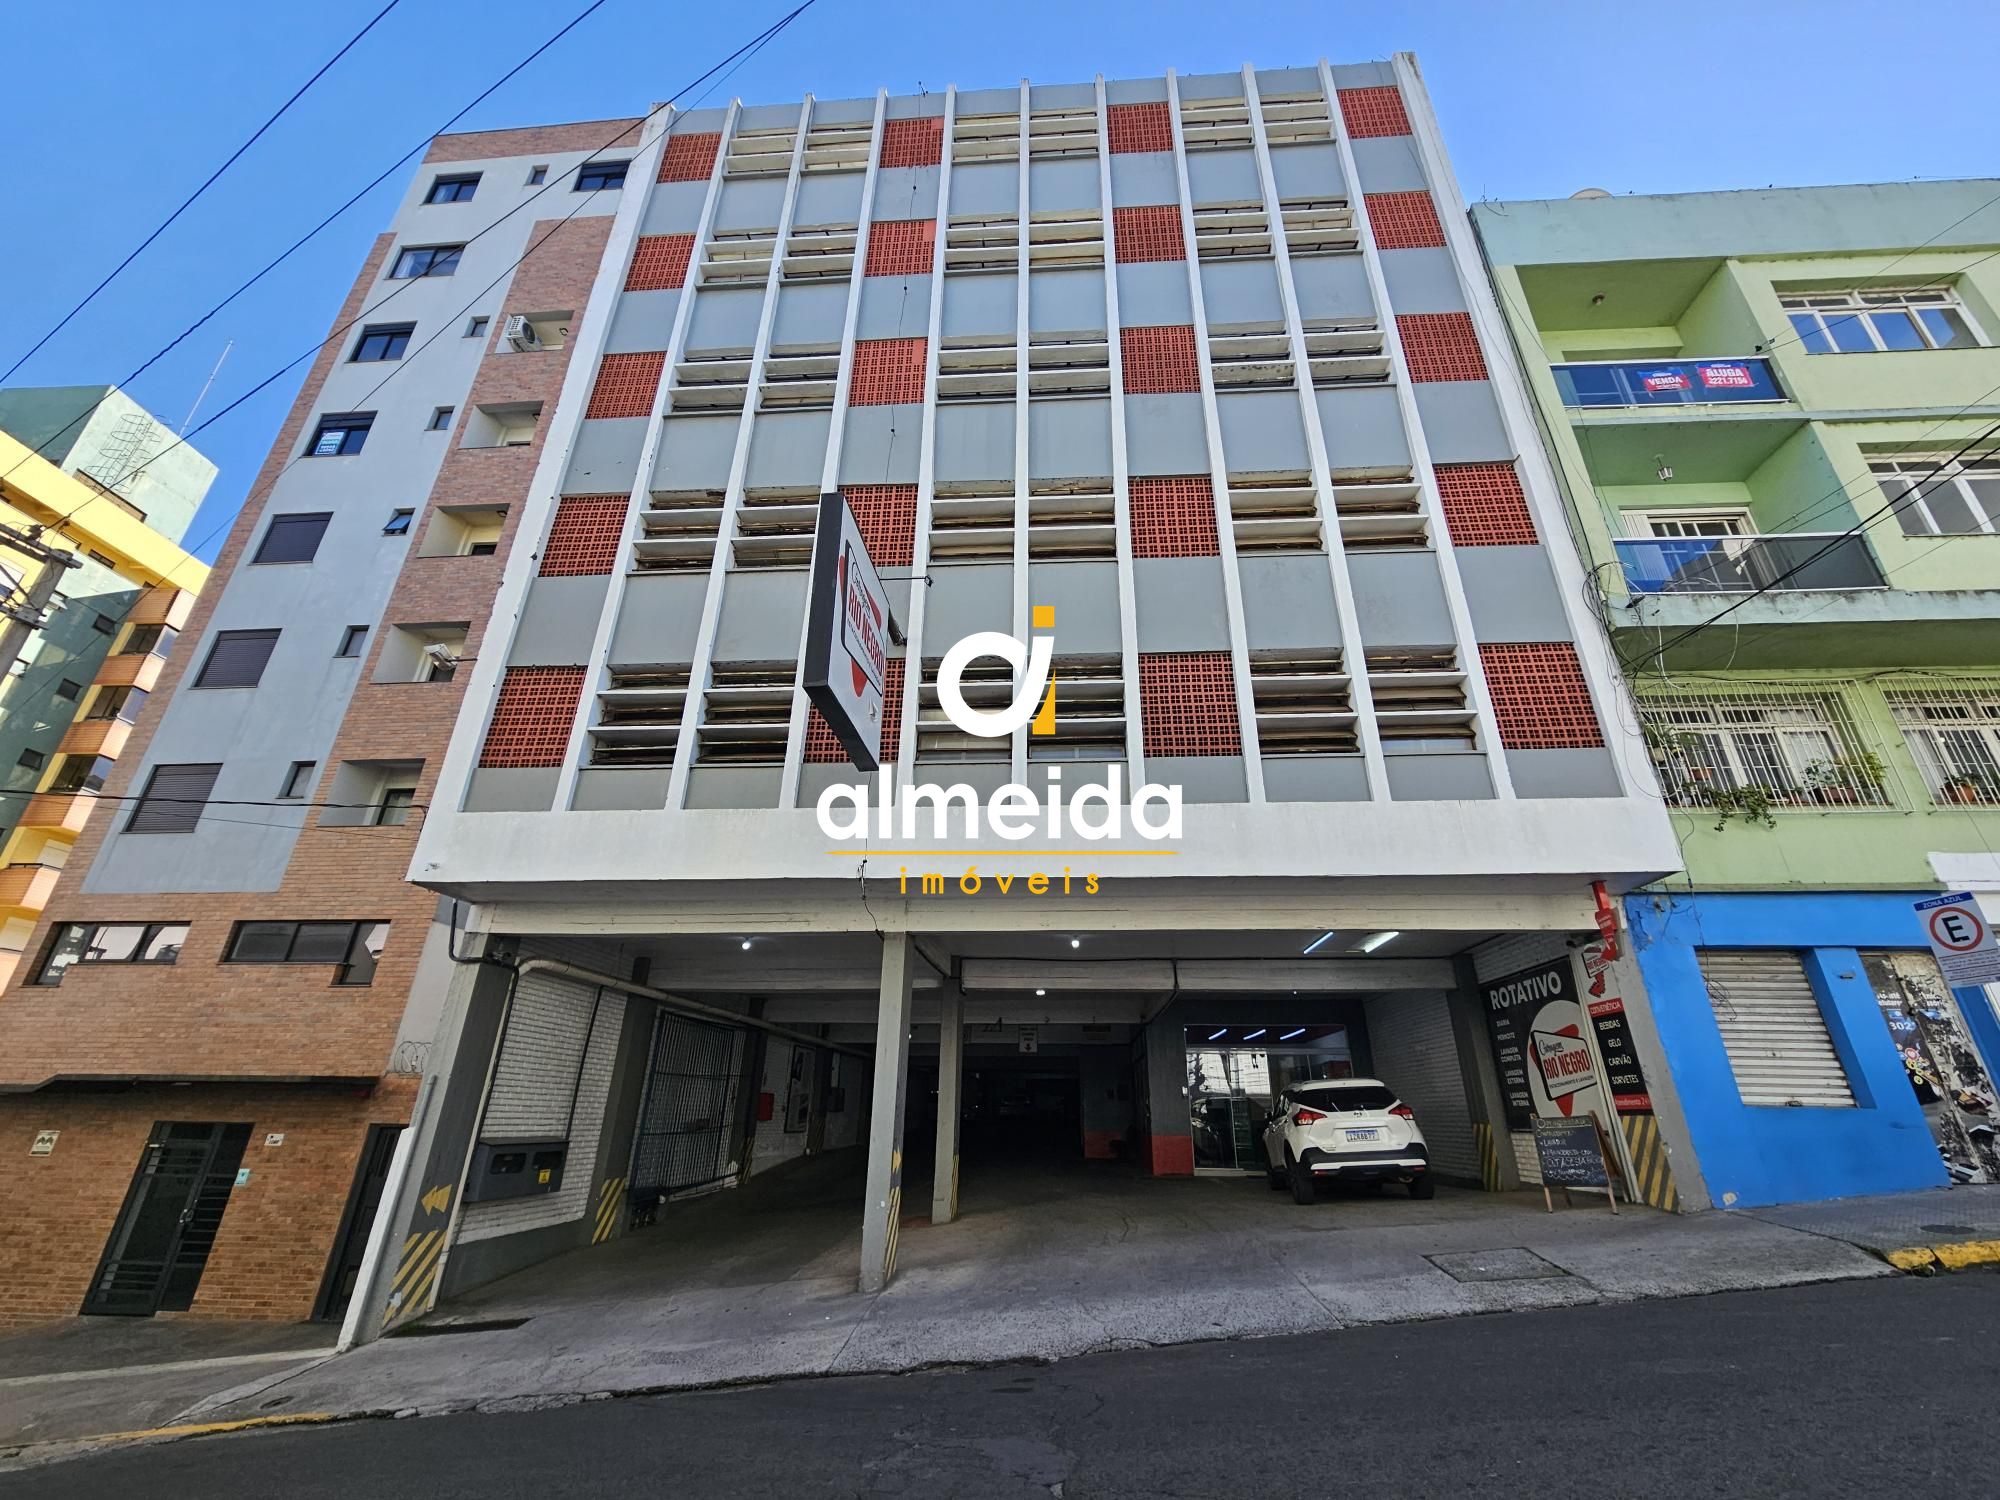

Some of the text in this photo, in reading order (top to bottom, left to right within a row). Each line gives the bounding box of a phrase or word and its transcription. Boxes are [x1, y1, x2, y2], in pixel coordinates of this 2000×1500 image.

[1706, 368, 1744, 377] ALUGA
[1648, 376, 1683, 385] VENDA
[848, 584, 884, 676] RIO NEGRO
[1922, 895, 1963, 909] ZONA AZUL
[1941, 915, 1970, 943] E
[1489, 971, 1562, 1010] ROTATIVO
[1599, 1019, 1621, 1030] BEBIDAS
[1608, 1038, 1621, 1048] GELO
[1543, 1049, 1591, 1080] RIO NEGRO
[1608, 1054, 1631, 1066] CARVÃO
[1611, 1074, 1639, 1085] SORVETES
